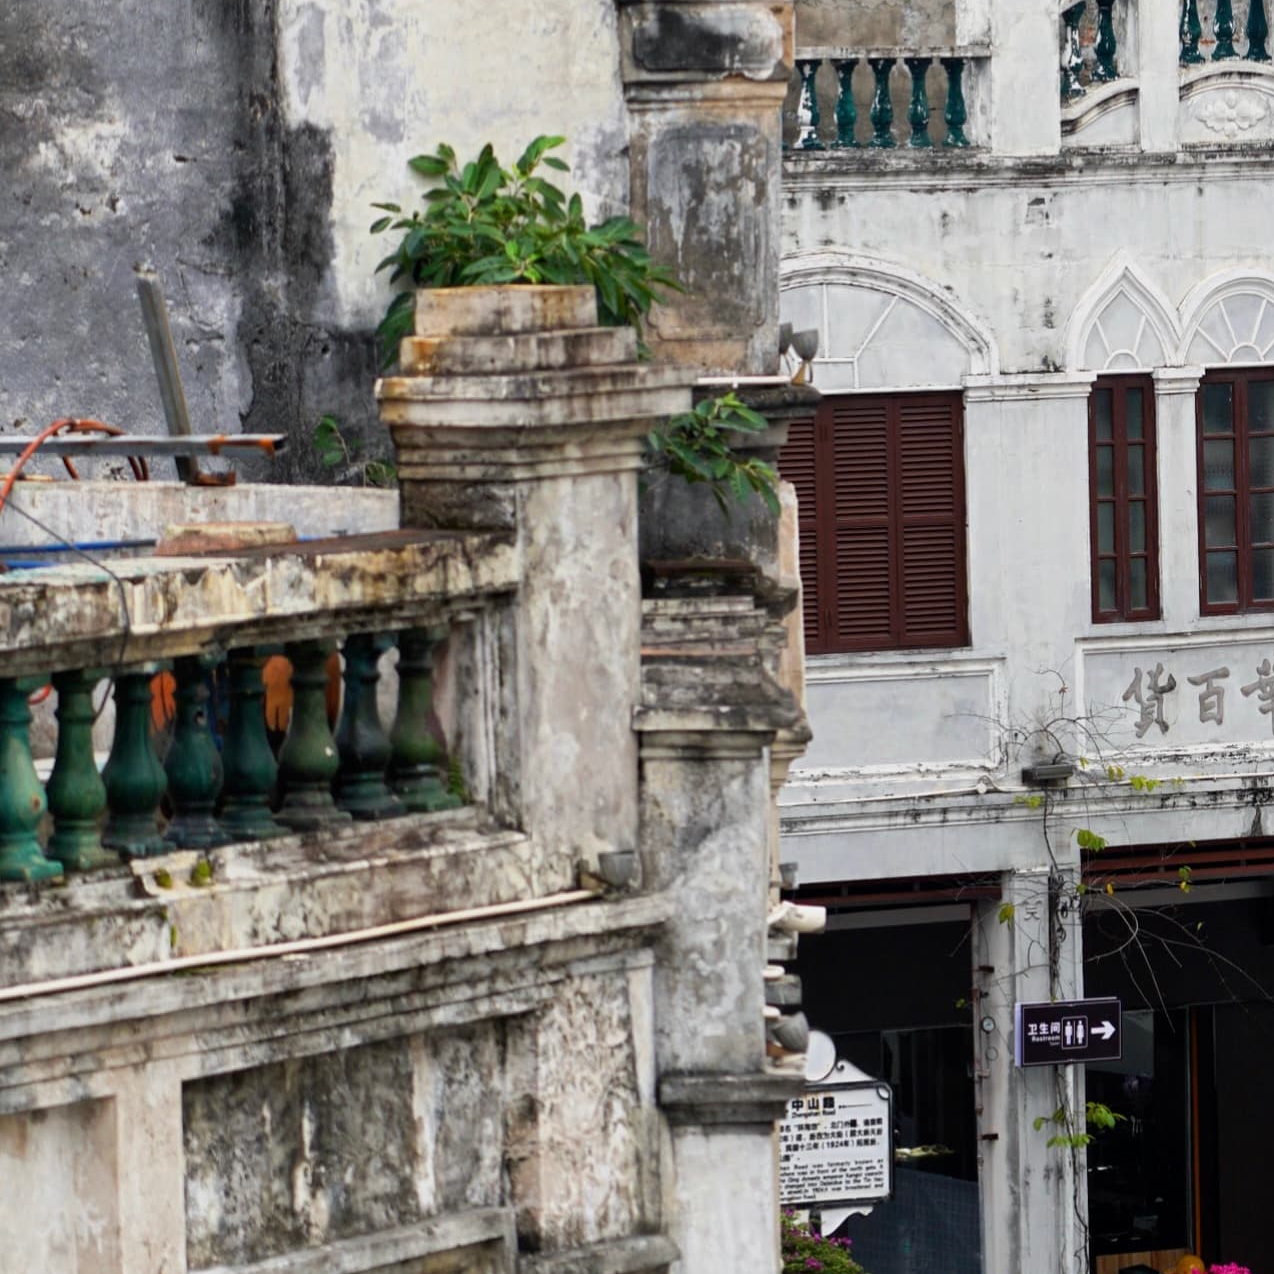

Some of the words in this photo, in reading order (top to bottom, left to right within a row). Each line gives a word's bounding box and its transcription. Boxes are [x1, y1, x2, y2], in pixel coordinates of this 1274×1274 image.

[1027, 1021, 1061, 1036] 卫生间
[791, 1096, 835, 1111] 中山路
